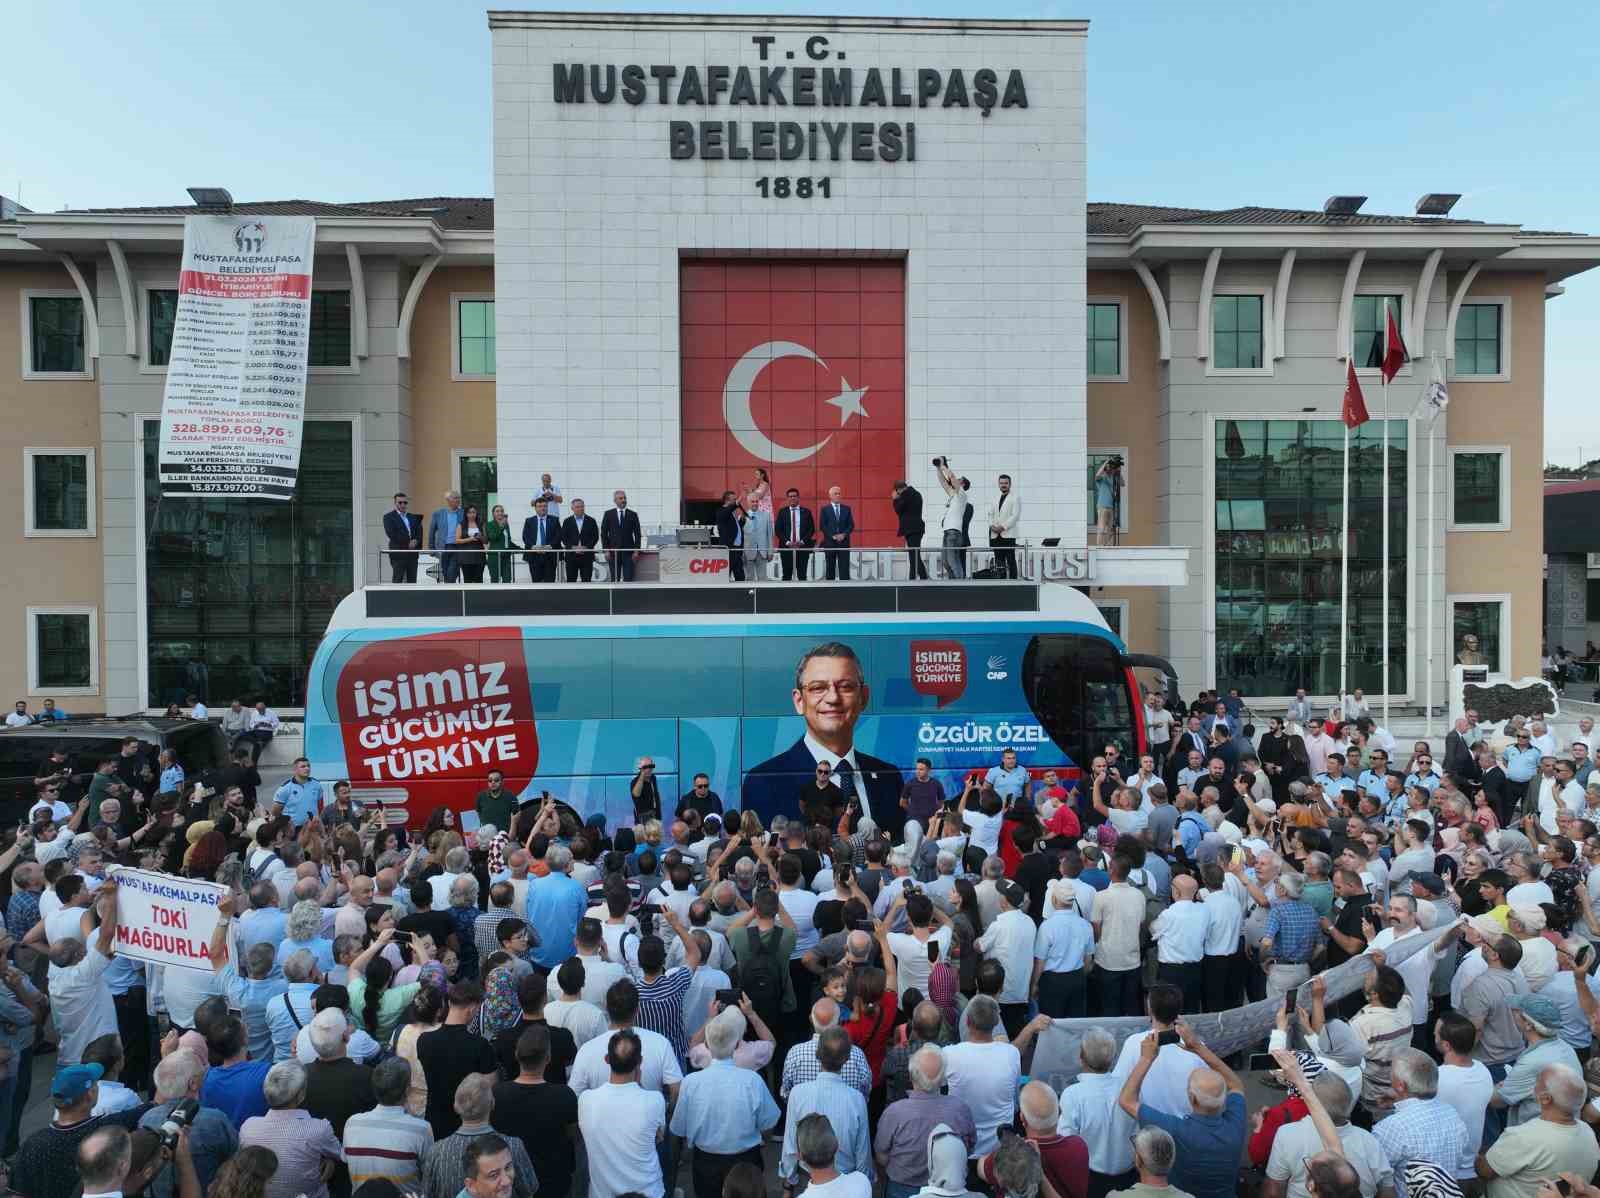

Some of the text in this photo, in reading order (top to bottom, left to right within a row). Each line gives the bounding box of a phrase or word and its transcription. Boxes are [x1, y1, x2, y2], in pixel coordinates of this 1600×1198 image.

[552, 63, 1029, 117] MUSTAFAKEMALPAŞA
[669, 120, 916, 162] BELEDİYESİ
[755, 177, 831, 199] 1881
[689, 558, 729, 574] CHP
[915, 663, 961, 673] GÜCÜMÜZ
[915, 673, 962, 683] TÜRKİYE
[986, 671, 1008, 680] CHP
[359, 702, 514, 749] GÜCÜMÜZ
[918, 722, 1050, 743] ÖZGÜR ÖZEL
[364, 733, 519, 782] TÜRKİYE
[151, 904, 188, 930] TOKİ
[116, 924, 230, 961] MAĞDURLAI
